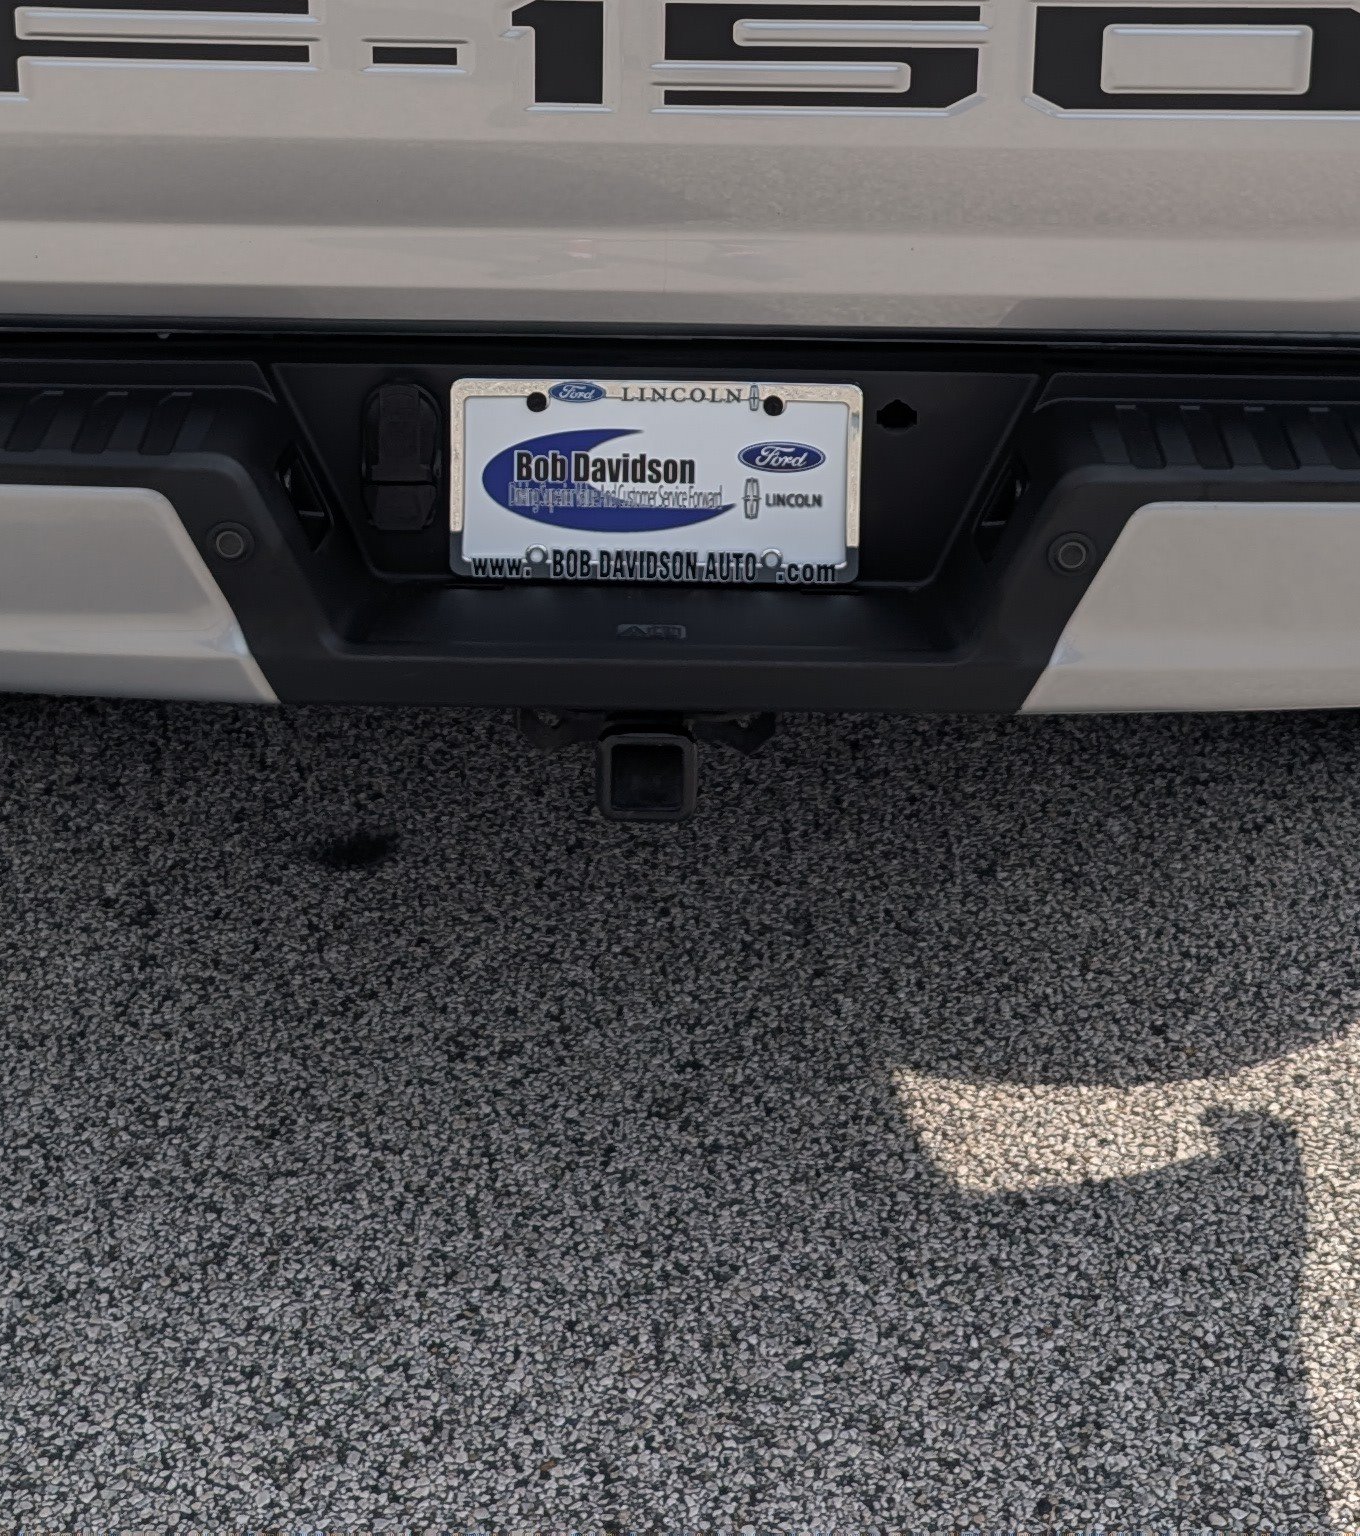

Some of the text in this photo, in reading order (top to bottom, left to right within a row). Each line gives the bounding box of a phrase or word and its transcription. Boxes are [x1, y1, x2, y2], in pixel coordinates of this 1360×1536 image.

[559, 382, 742, 404] Ford LINCOLN
[515, 451, 695, 484] Bob Davidson
[753, 446, 808, 468] Ford
[765, 494, 823, 507] LINCOLN
[552, 550, 591, 578] BOB
[598, 550, 697, 580] DAVIDSON
[705, 552, 757, 581] AUTO
